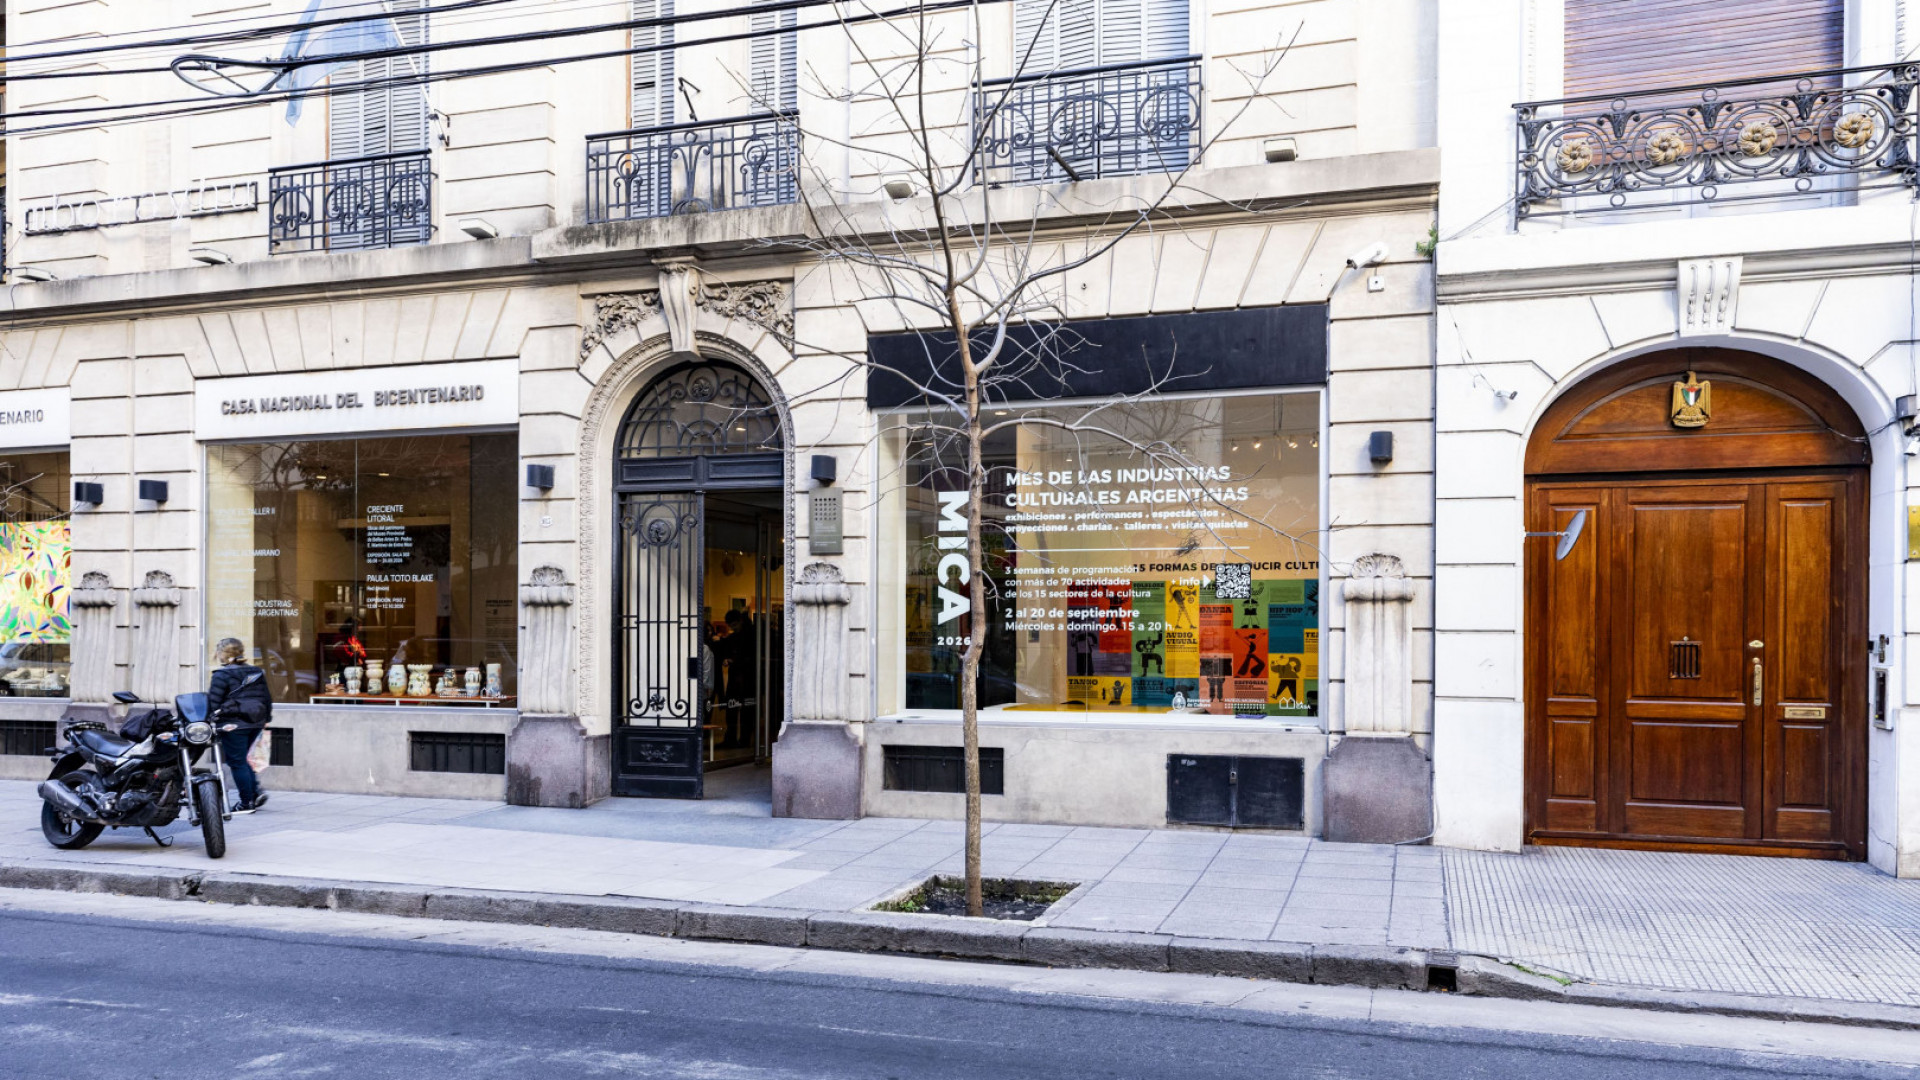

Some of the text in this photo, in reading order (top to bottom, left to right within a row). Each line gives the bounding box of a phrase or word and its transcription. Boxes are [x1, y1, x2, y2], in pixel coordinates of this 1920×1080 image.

[221, 384, 485, 416] CASA NACIONAL DEL BICENTENARIO
[1006, 465, 1231, 487] MES DE LAS INDUSTRIAS
[1005, 486, 1249, 507] CULTURALES ARGENTINAS
[366, 504, 404, 513] CRECIENTE
[366, 514, 395, 523] LITORAL
[1005, 512, 1066, 521] exhibiciones
[1075, 510, 1143, 523] performances
[1005, 523, 1068, 534] proyecciones
[1077, 522, 1113, 531] charlas
[1123, 521, 1162, 531] talleres
[1209, 519, 1249, 531] guiadas
[938, 490, 971, 625] MICA
[1005, 564, 1139, 577] 3 semanas de programación
[1149, 563, 1197, 572] FORMAS
[1201, 562, 1216, 571] DE
[366, 573, 434, 583] PAULA TOTO BLAKE
[1024, 577, 1044, 586] más
[1046, 577, 1059, 586] de
[1061, 578, 1073, 586] 70
[1075, 576, 1131, 586] actividades
[1179, 576, 1200, 586] info
[1005, 588, 1151, 598] de los 15 sectores de la cultura
[257, 608, 299, 617] ARGENTINAS
[1005, 606, 1140, 620] 2 al 20 de septiembre
[1005, 620, 1055, 632] Miércoles
[1057, 623, 1065, 631] a
[1067, 621, 1119, 634] domingo,
[1122, 621, 1135, 631] 15
[1137, 623, 1145, 631] a
[1148, 621, 1162, 631] 20
[937, 636, 971, 646] 2026
